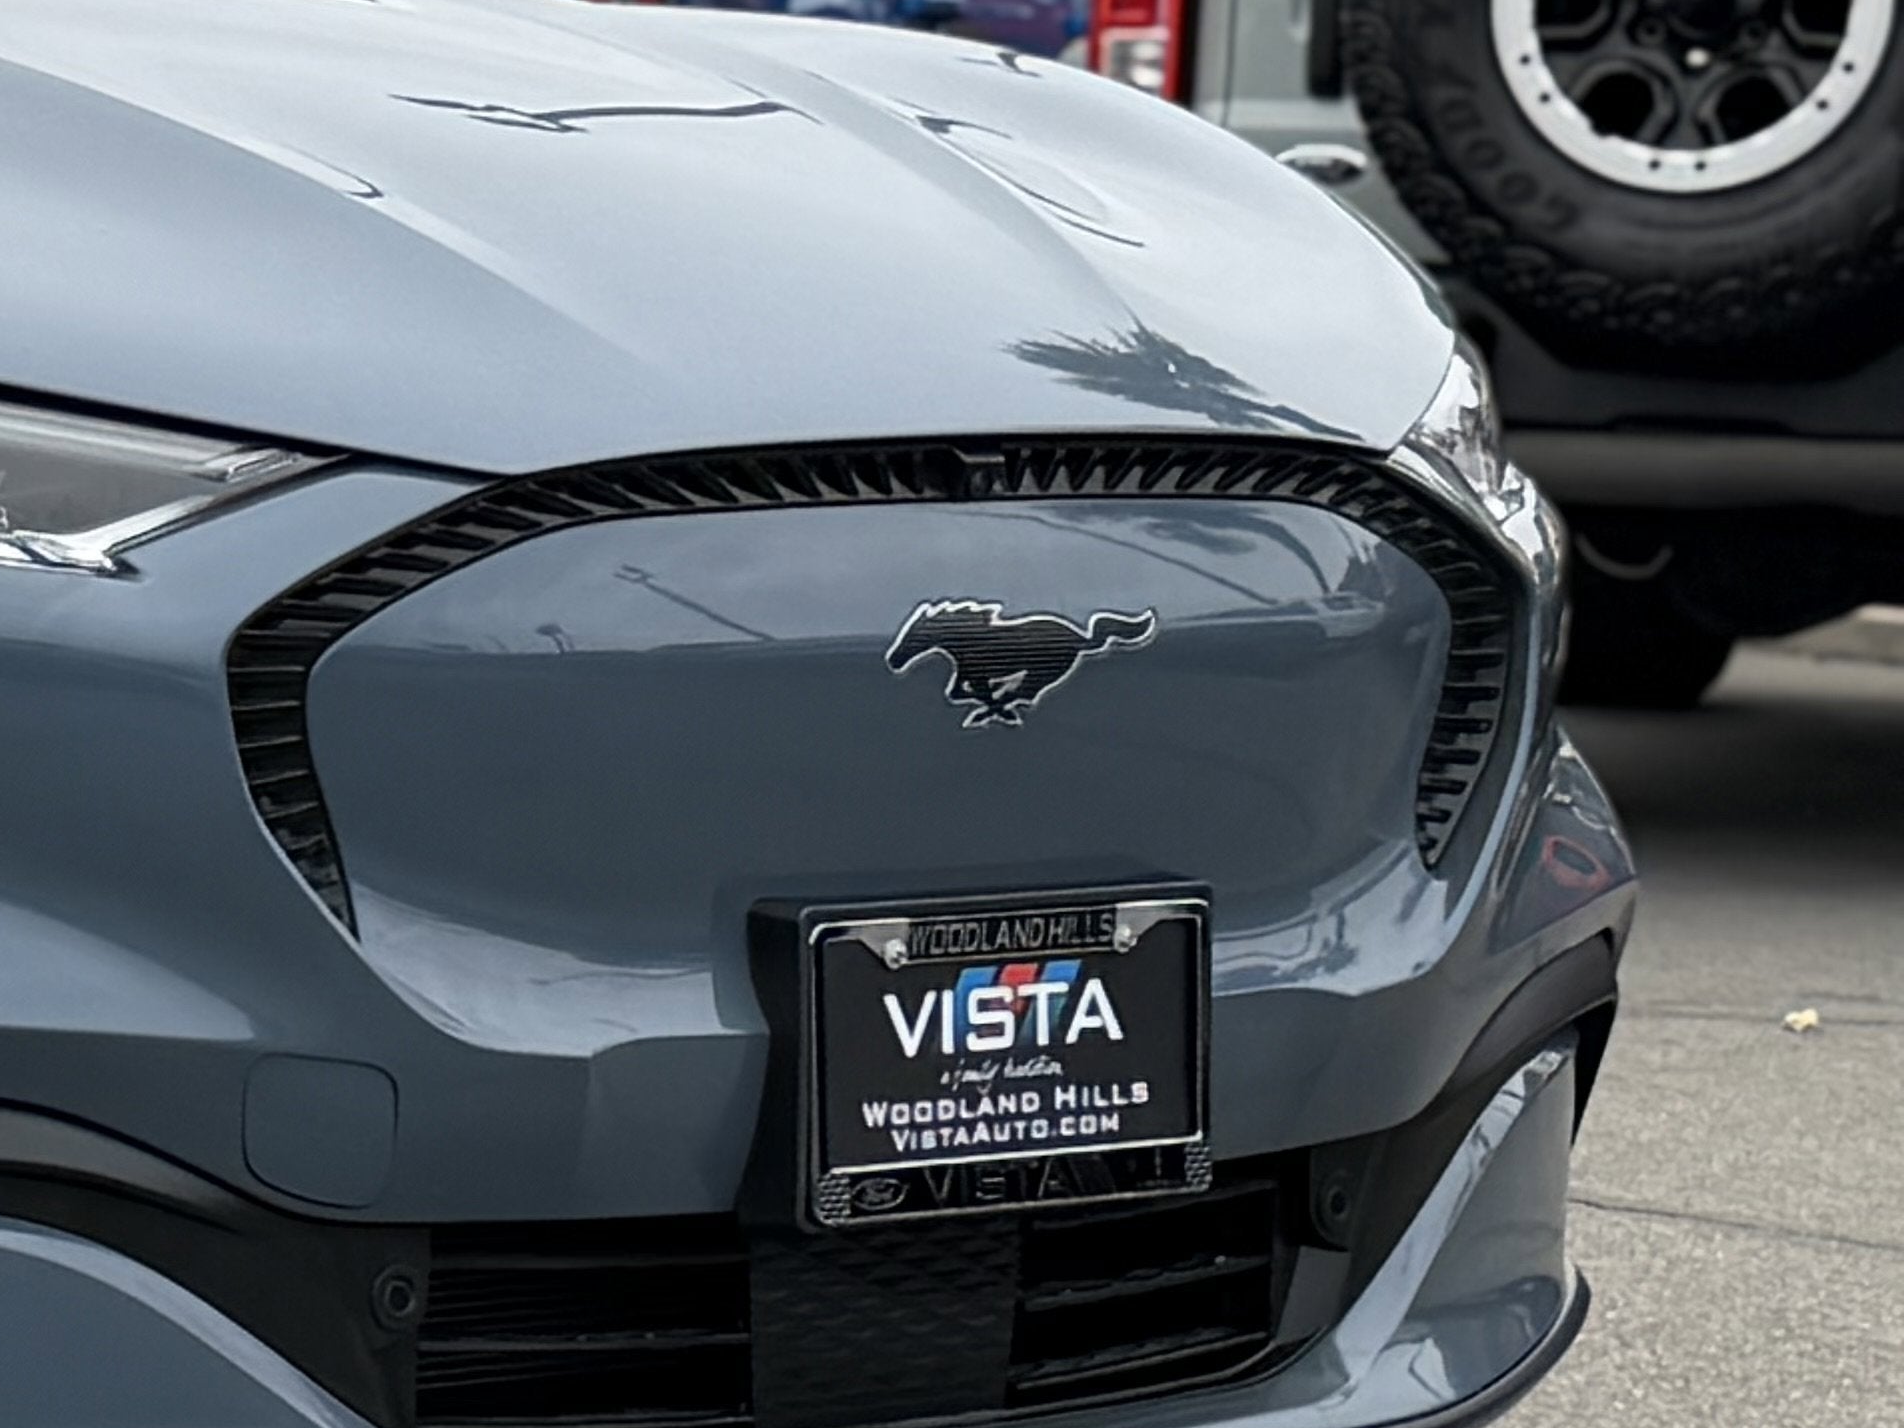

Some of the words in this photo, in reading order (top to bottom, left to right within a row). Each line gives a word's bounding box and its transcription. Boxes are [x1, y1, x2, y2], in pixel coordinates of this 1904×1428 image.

[910, 917, 1043, 956] WOODLAND
[1048, 913, 1113, 947] HILLS
[882, 977, 1124, 1059] VISTA
